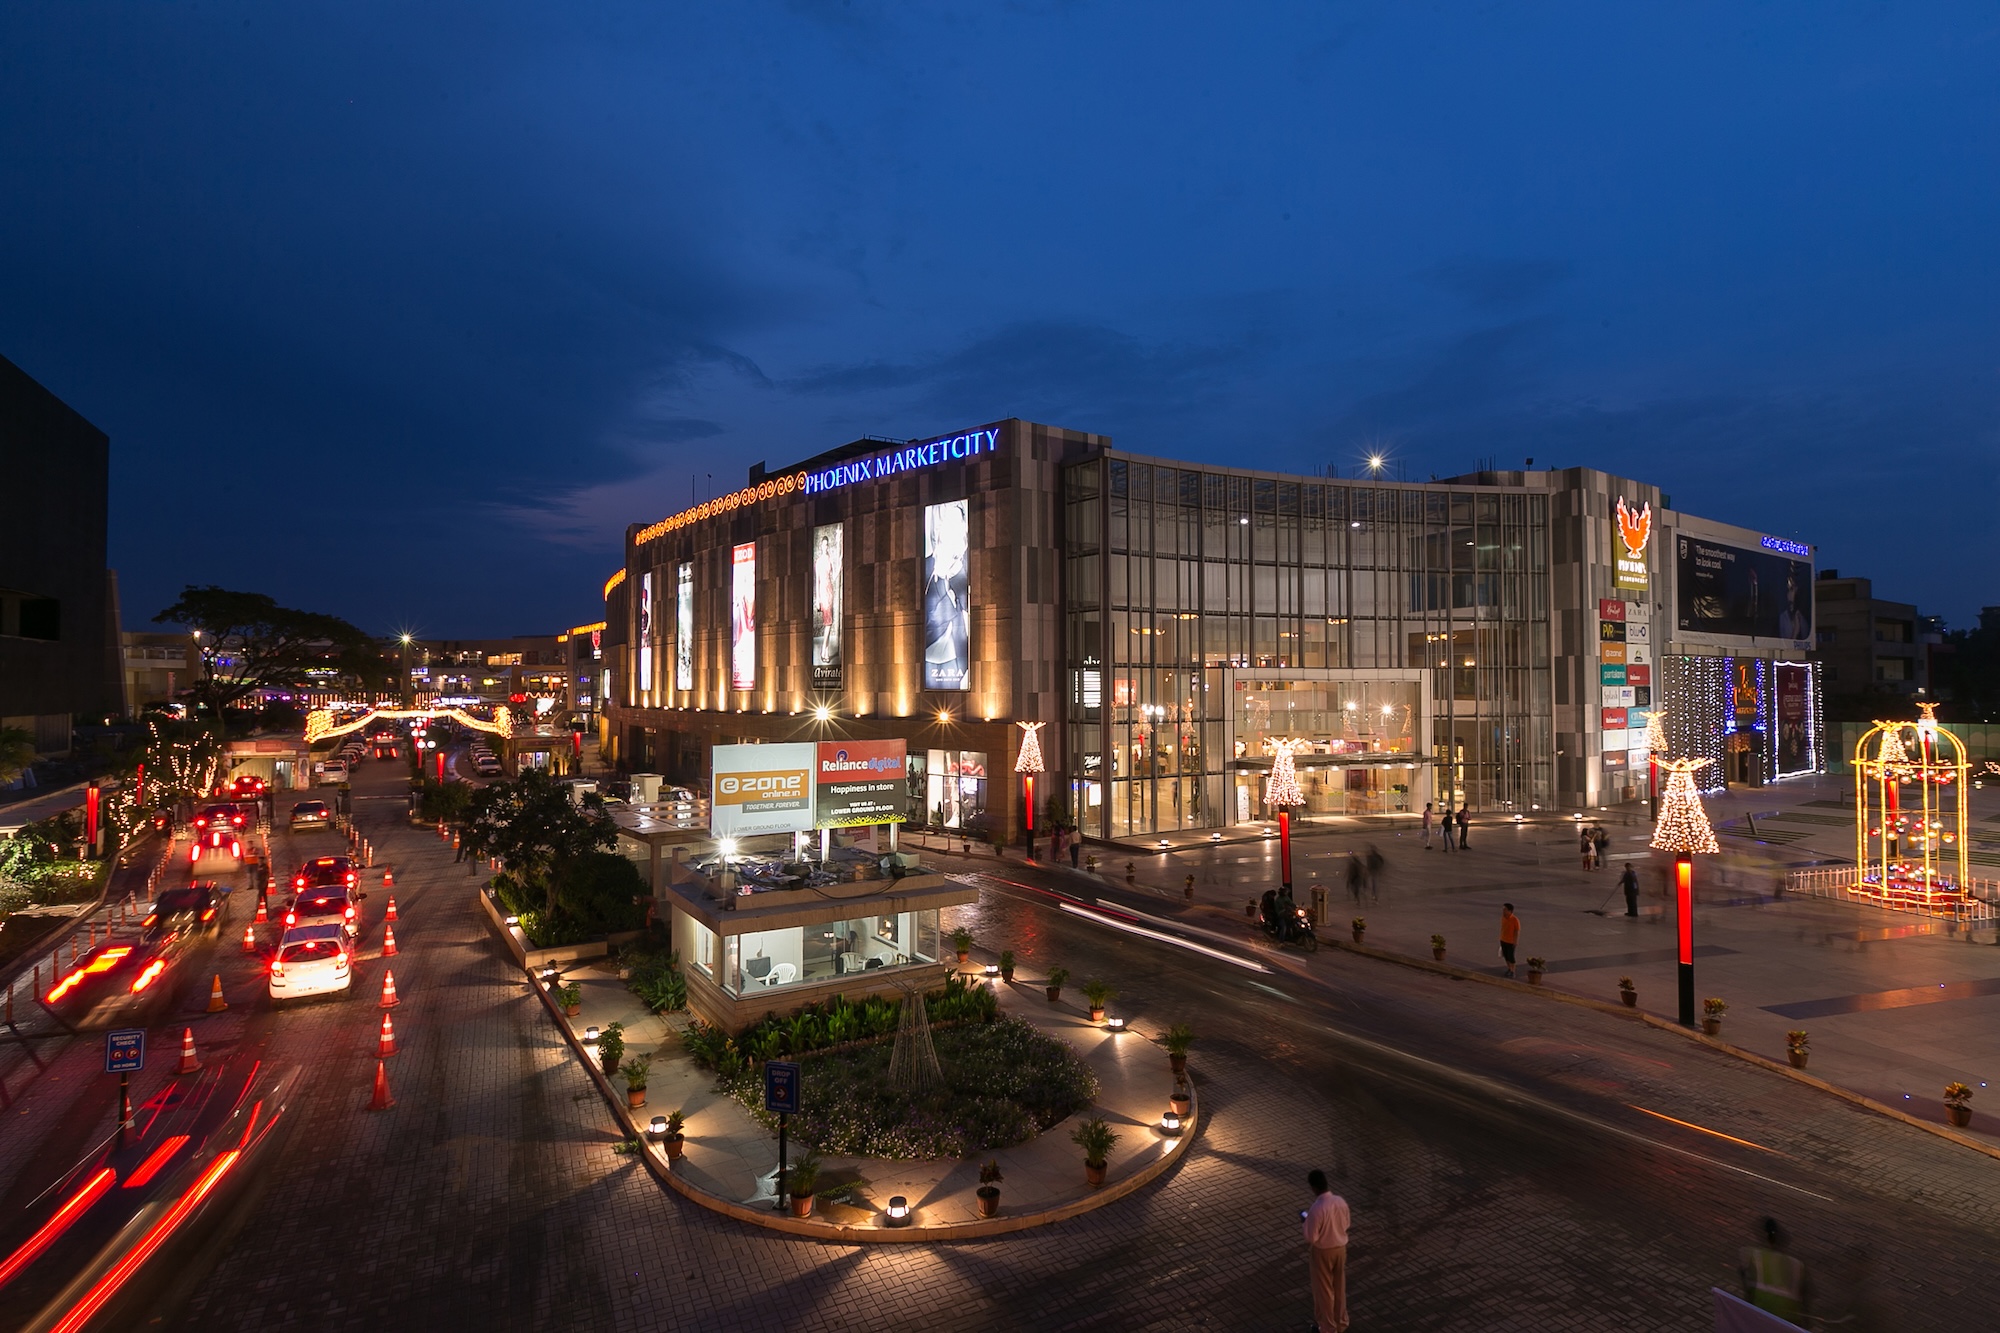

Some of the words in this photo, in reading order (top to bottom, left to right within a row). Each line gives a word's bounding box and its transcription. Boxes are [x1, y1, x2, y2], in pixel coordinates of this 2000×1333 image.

[805, 459, 872, 495] PHOENIX
[875, 428, 999, 478] MARKETCITY
[1628, 608, 1647, 616] ZARA
[1603, 623, 1614, 638] PVR
[931, 669, 964, 677] ZARA
[762, 789, 800, 799] online.in
[830, 785, 867, 796] Happiness
[876, 783, 894, 791] store
